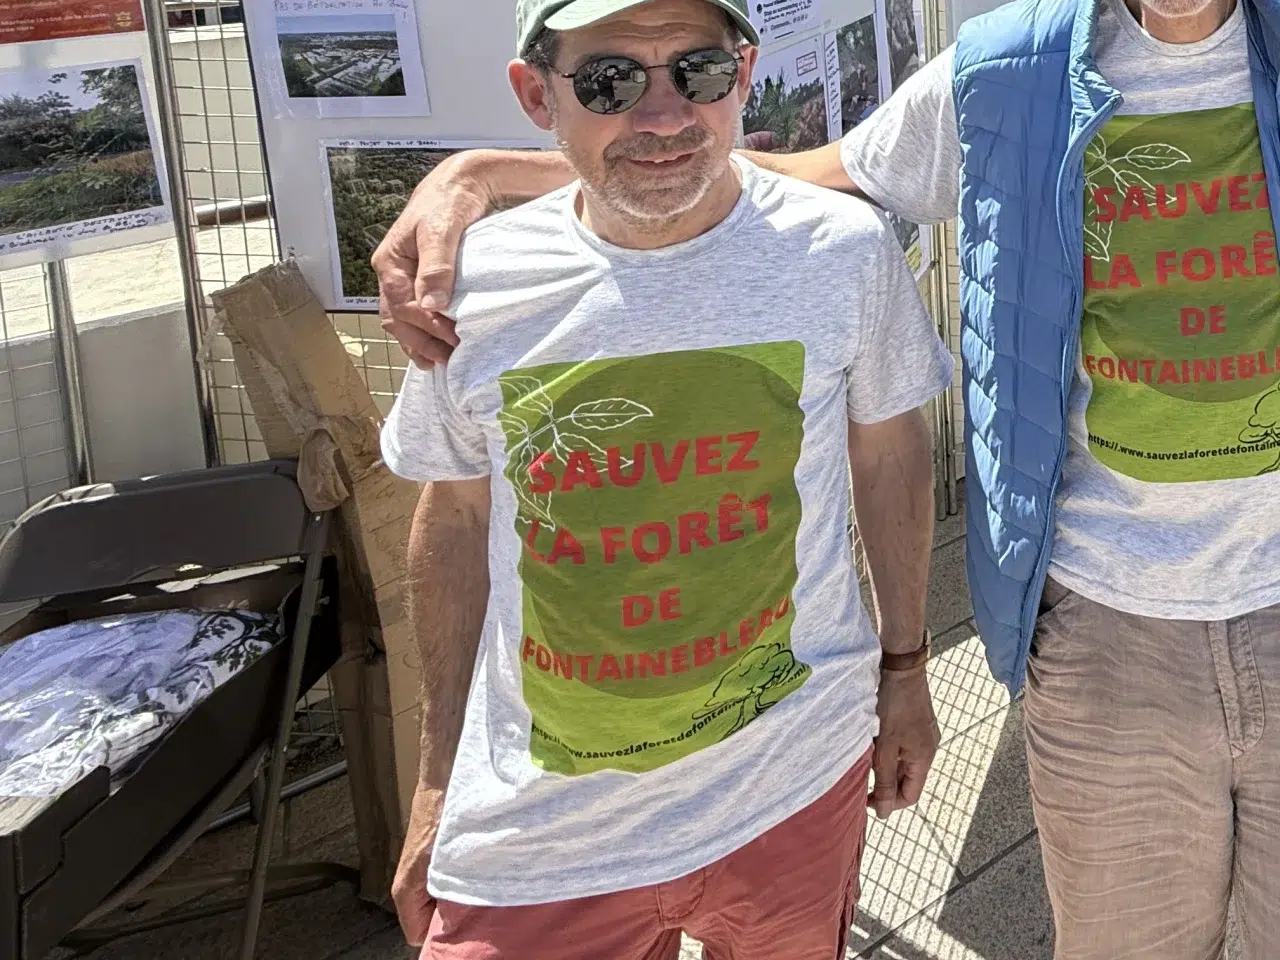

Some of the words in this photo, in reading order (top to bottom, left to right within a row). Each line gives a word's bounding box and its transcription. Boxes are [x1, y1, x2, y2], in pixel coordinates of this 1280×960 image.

[1094, 172, 1271, 223] SAUVEZ
[1084, 253, 1143, 290] LA
[1179, 305, 1228, 337] DE
[528, 430, 761, 494] SAUVEZ
[524, 519, 586, 566] LA
[600, 492, 773, 565] FORÊT
[620, 587, 682, 629] DE
[522, 595, 791, 685] FONTAINEBLEAU
